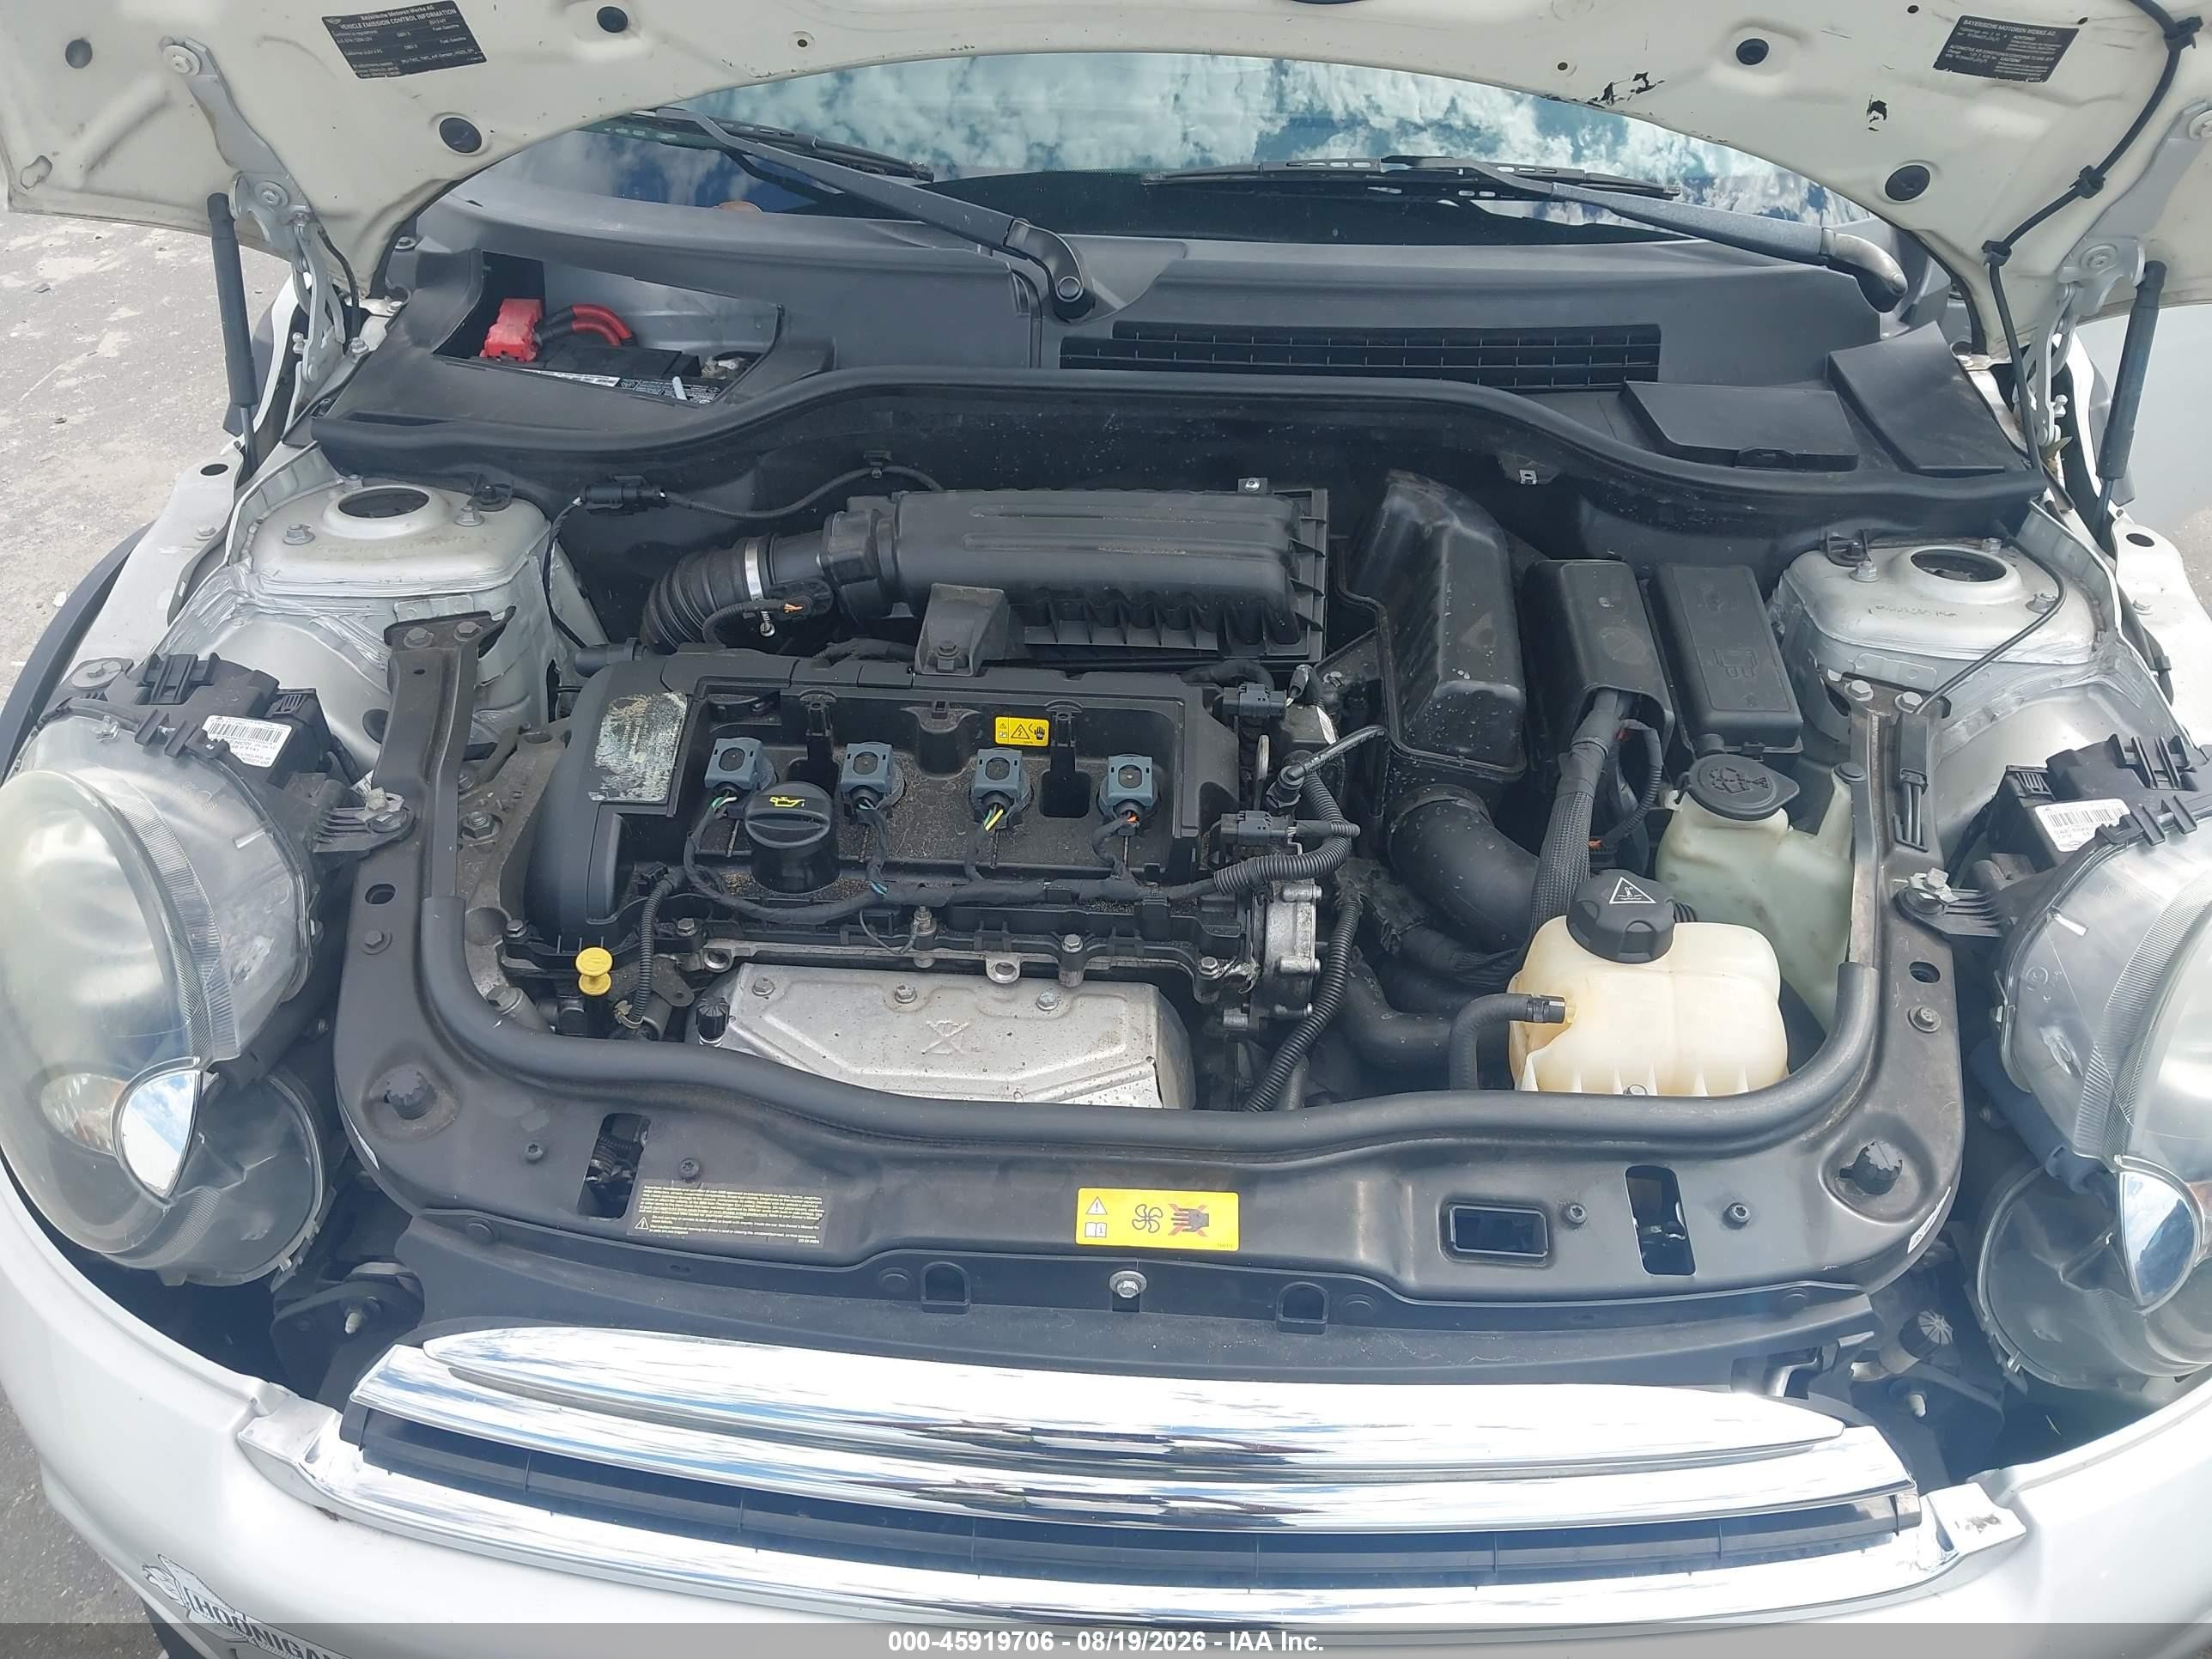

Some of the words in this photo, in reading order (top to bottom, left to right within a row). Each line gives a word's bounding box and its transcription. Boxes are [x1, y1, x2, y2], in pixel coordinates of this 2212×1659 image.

[362, 19, 391, 27] EMISSION
[390, 15, 418, 25] CONTROL
[416, 9, 457, 21] INFORMATION
[1998, 24, 2027, 33] MOTOREN
[192, 1594, 335, 1659] HOONIGA
